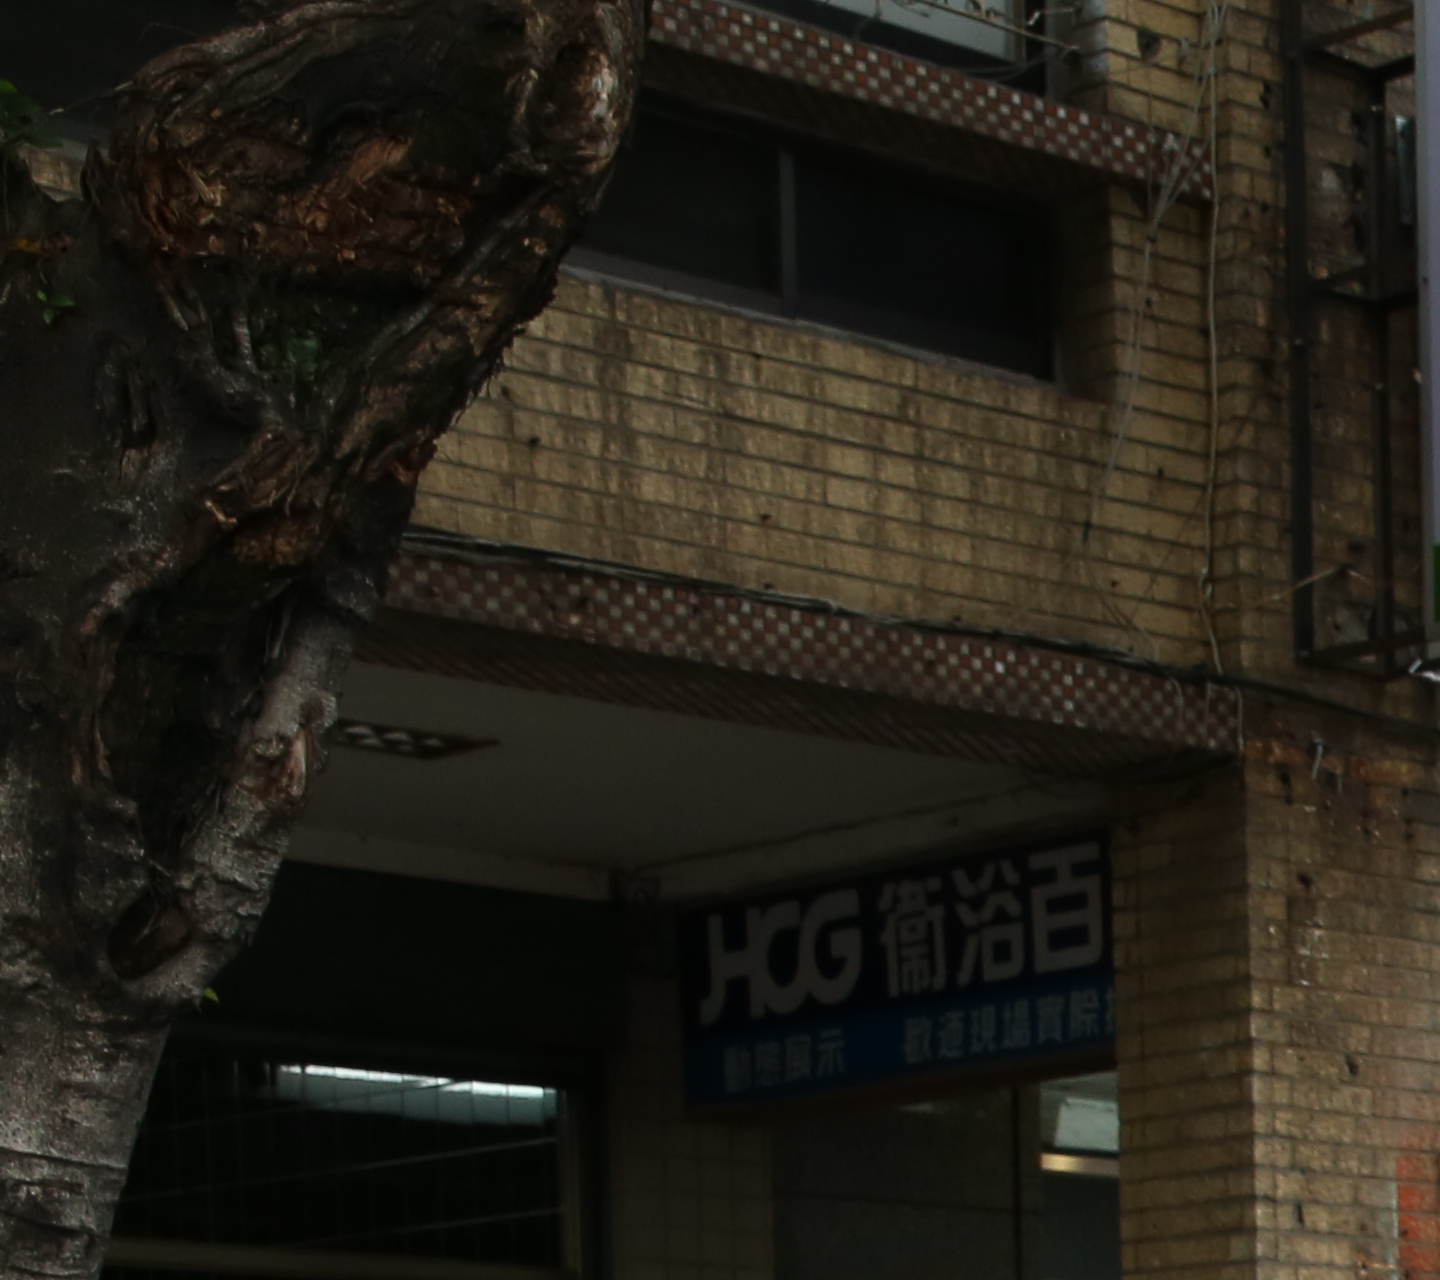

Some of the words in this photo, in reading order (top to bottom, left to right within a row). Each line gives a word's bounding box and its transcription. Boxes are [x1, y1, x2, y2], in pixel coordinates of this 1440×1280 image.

[699, 888, 863, 1028] HCG
[902, 988, 1116, 1065] 歡迎現場實際
